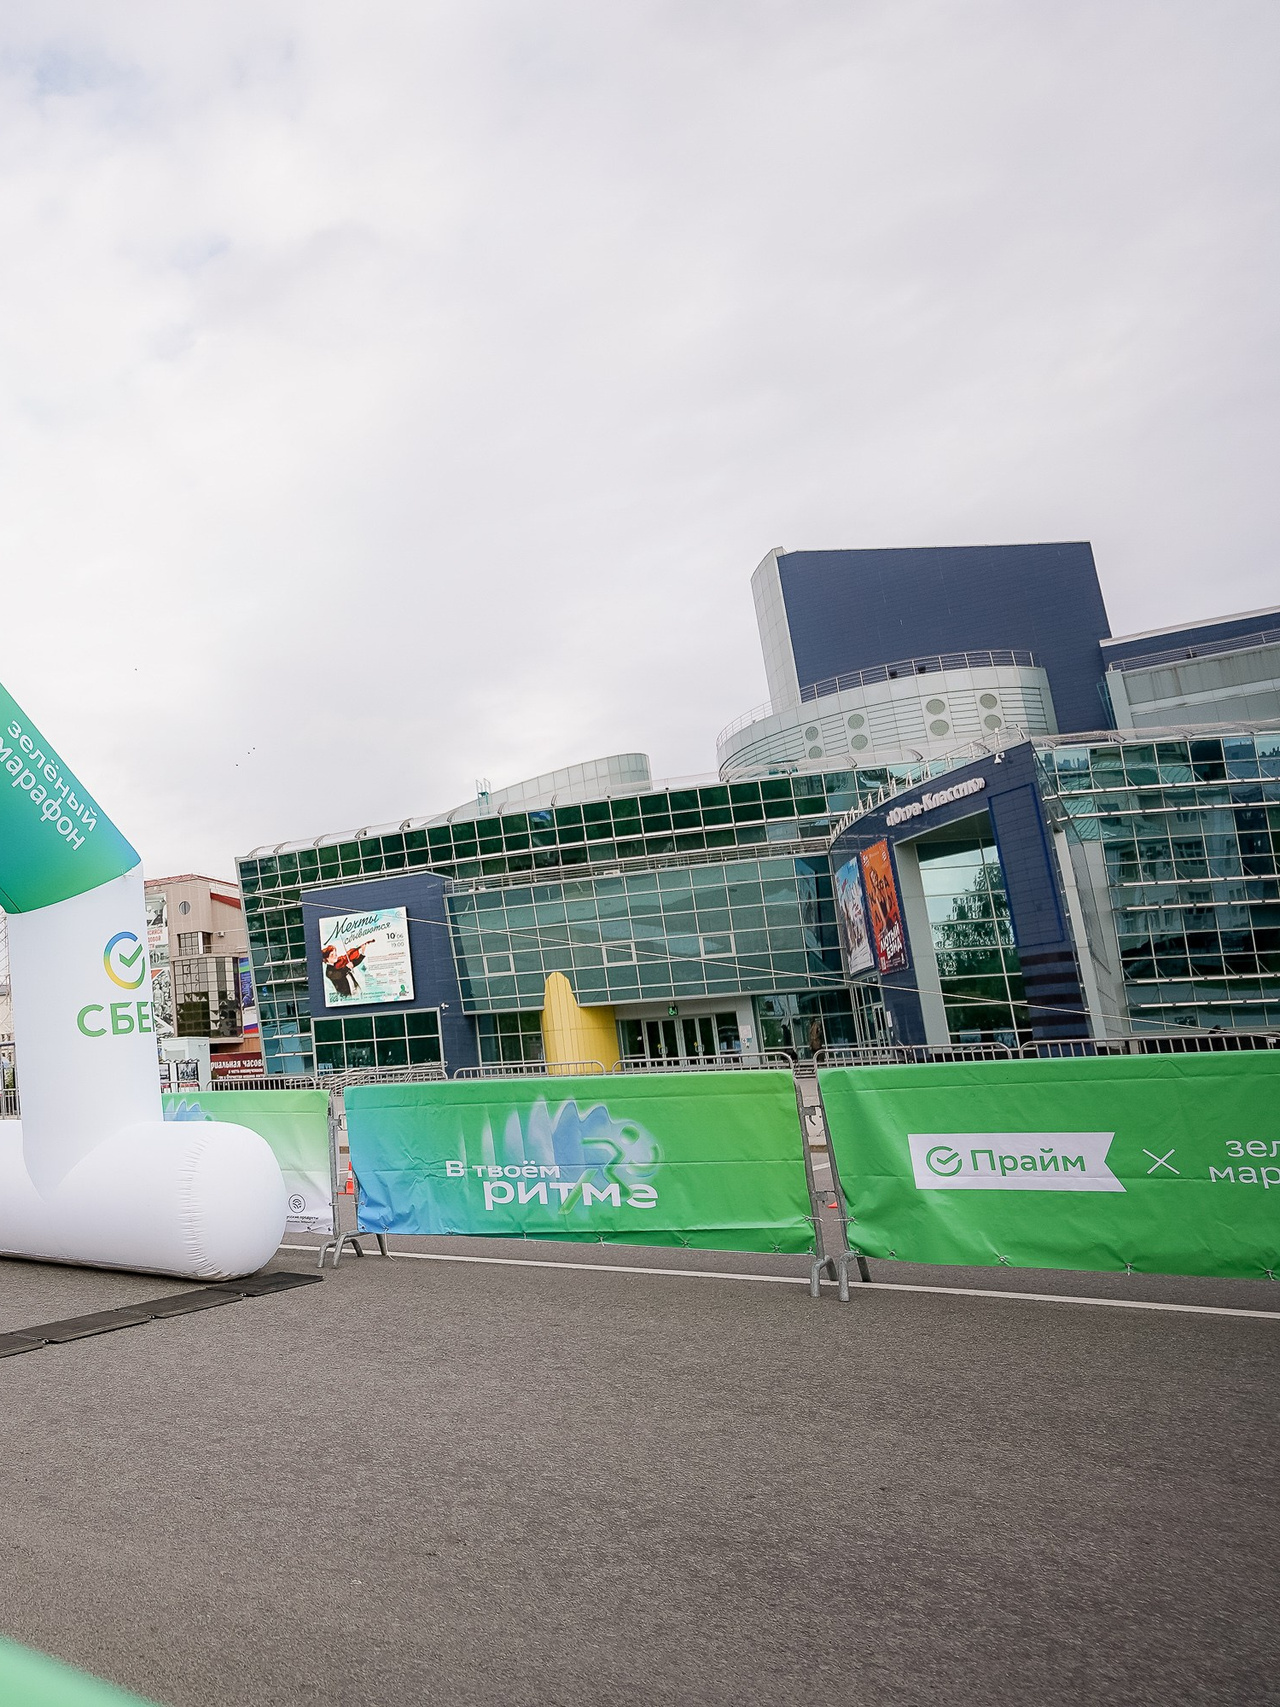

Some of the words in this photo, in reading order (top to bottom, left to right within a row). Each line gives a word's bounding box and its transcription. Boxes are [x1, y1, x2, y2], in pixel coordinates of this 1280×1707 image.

[6, 719, 98, 832] зелёный
[323, 914, 380, 946] Мечты
[344, 922, 392, 945] сбываются
[76, 1001, 156, 1038] СБЕ
[445, 1160, 465, 1178] В
[472, 1159, 560, 1179] твоём
[971, 1149, 1086, 1177] Прайм
[483, 1180, 659, 1211] ритме
